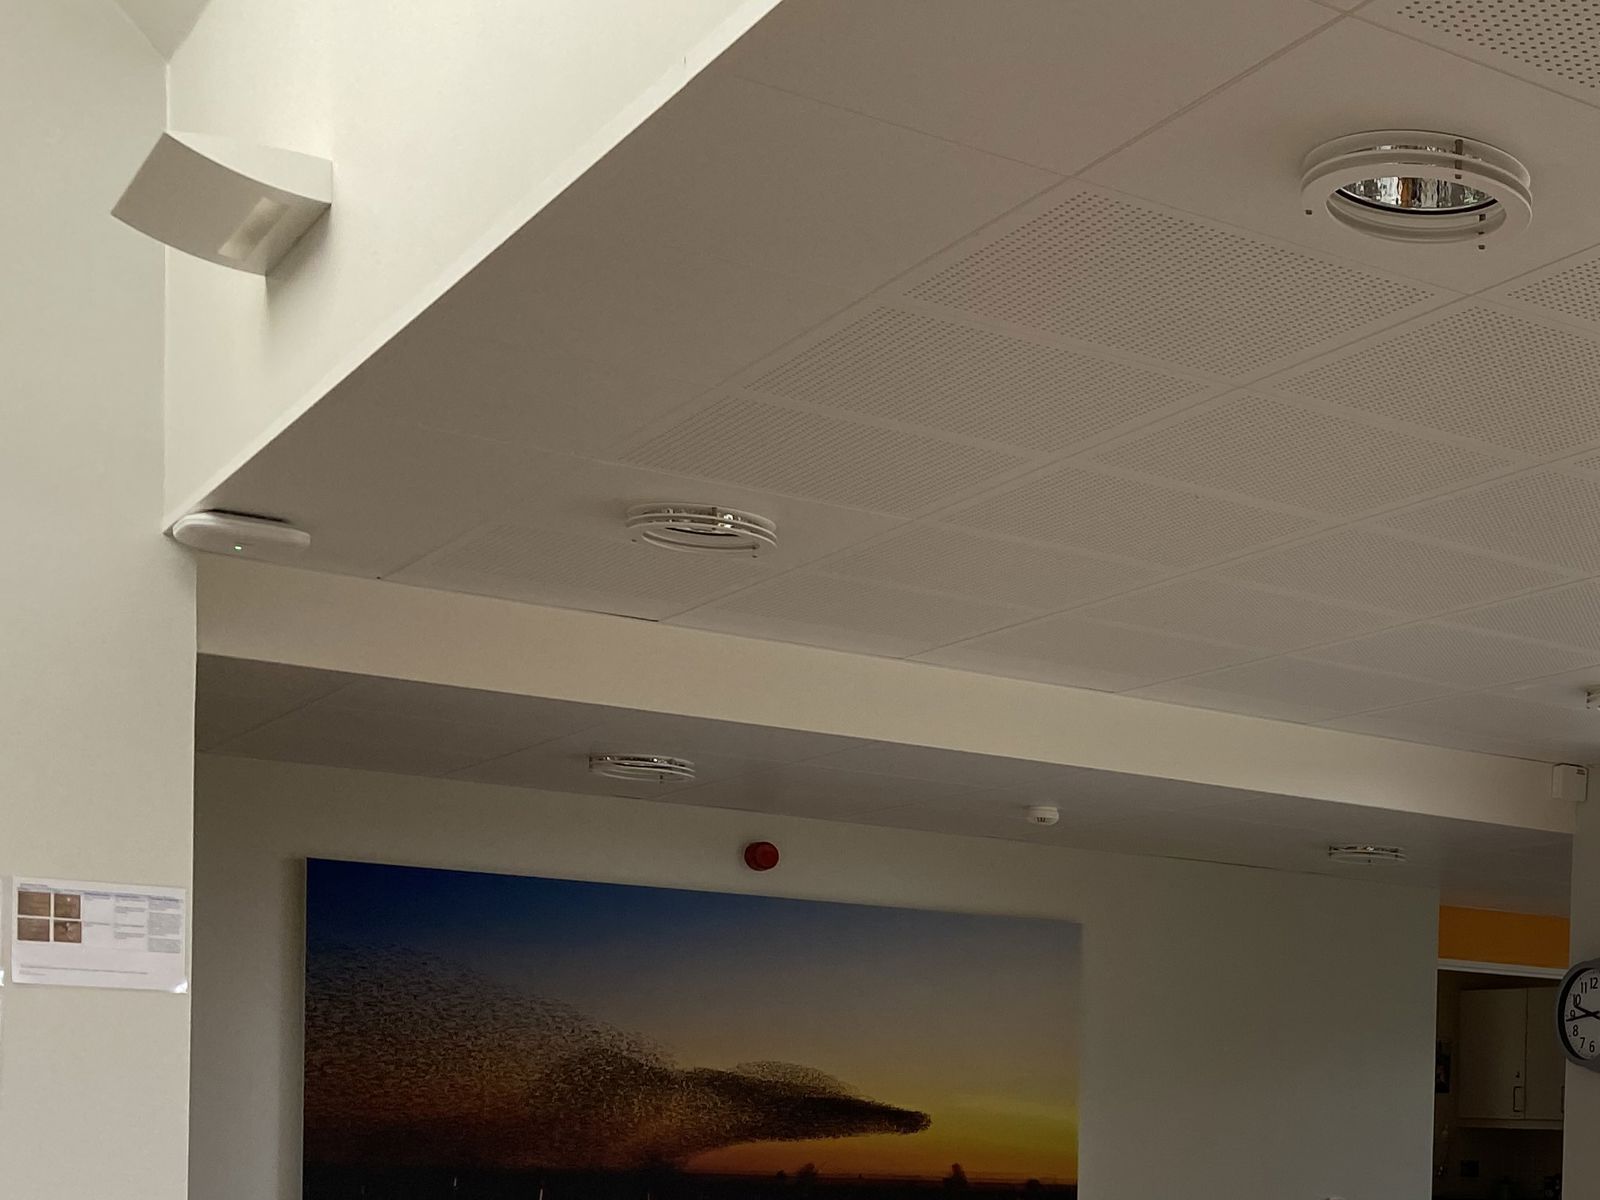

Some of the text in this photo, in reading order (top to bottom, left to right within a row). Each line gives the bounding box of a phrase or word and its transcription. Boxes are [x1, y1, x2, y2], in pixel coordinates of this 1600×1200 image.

[1581, 981, 1587, 994] 11
[1590, 977, 1598, 989] 12
[1573, 994, 1581, 1007] 10
[1570, 1010, 1576, 1020] 9
[1573, 1025, 1578, 1036] 8
[1580, 1037, 1585, 1048] 7
[1589, 1041, 1595, 1053] 6
